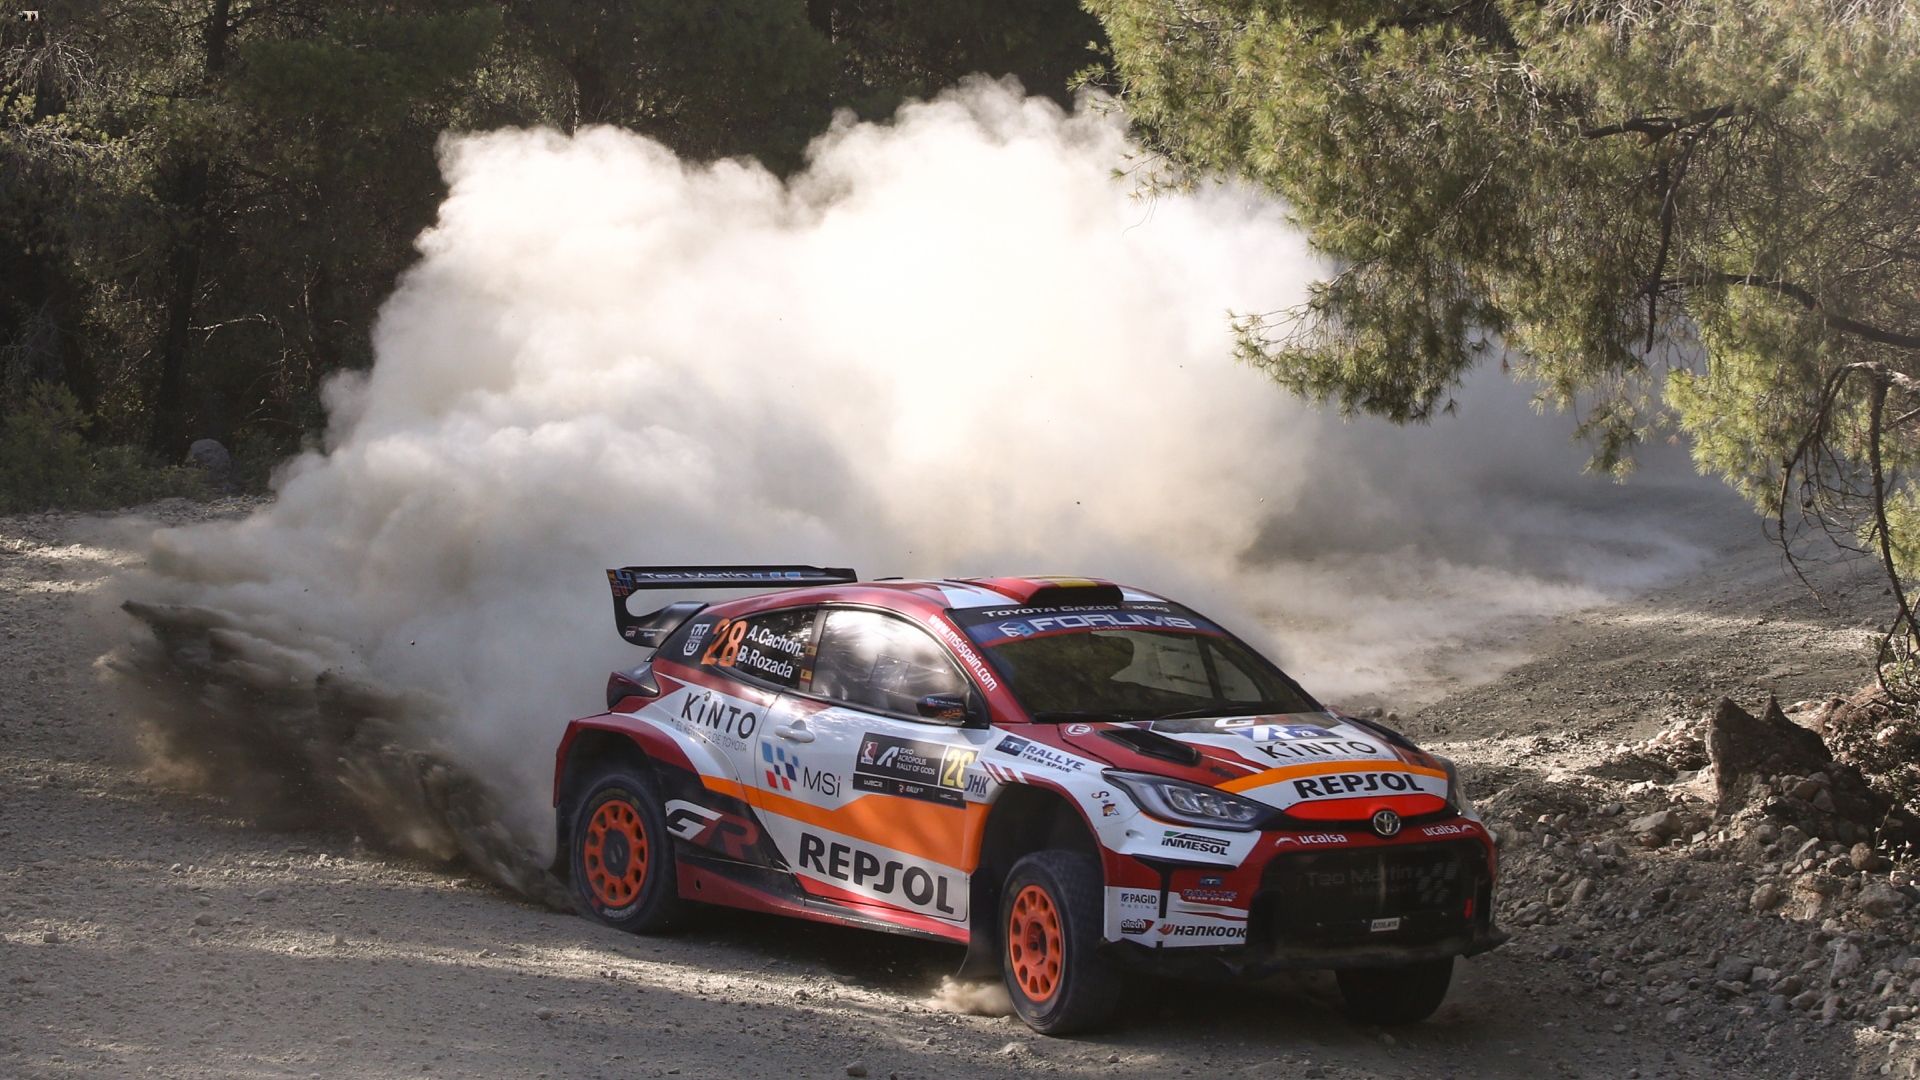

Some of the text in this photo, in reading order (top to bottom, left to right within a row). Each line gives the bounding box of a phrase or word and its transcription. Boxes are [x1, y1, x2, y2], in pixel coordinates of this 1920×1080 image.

[982, 607, 1056, 618] TOYOTA
[1060, 604, 1118, 613] GAZOO
[1028, 613, 1197, 632] FORUM8
[701, 618, 748, 668] 28
[746, 624, 801, 656] A.Cachón
[737, 645, 794, 679] B.Rozada
[928, 613, 998, 692] www.msispain.com
[722, 736, 747, 753] TOYOTA
[897, 755, 927, 766] ACROPOLIS
[1021, 753, 1073, 774] TEAM SPAIN
[1025, 745, 1085, 771] RALLYE
[896, 762, 936, 776] RALLY OF GODS
[964, 774, 991, 795] JHK
[1292, 773, 1425, 799] REPSOL
[665, 799, 762, 862] GR
[1299, 824, 1461, 845] ucalsa ucalsa
[799, 831, 954, 915] REPSOL
[1130, 893, 1157, 904] PAGID
[1183, 888, 1238, 899] RALLYE
